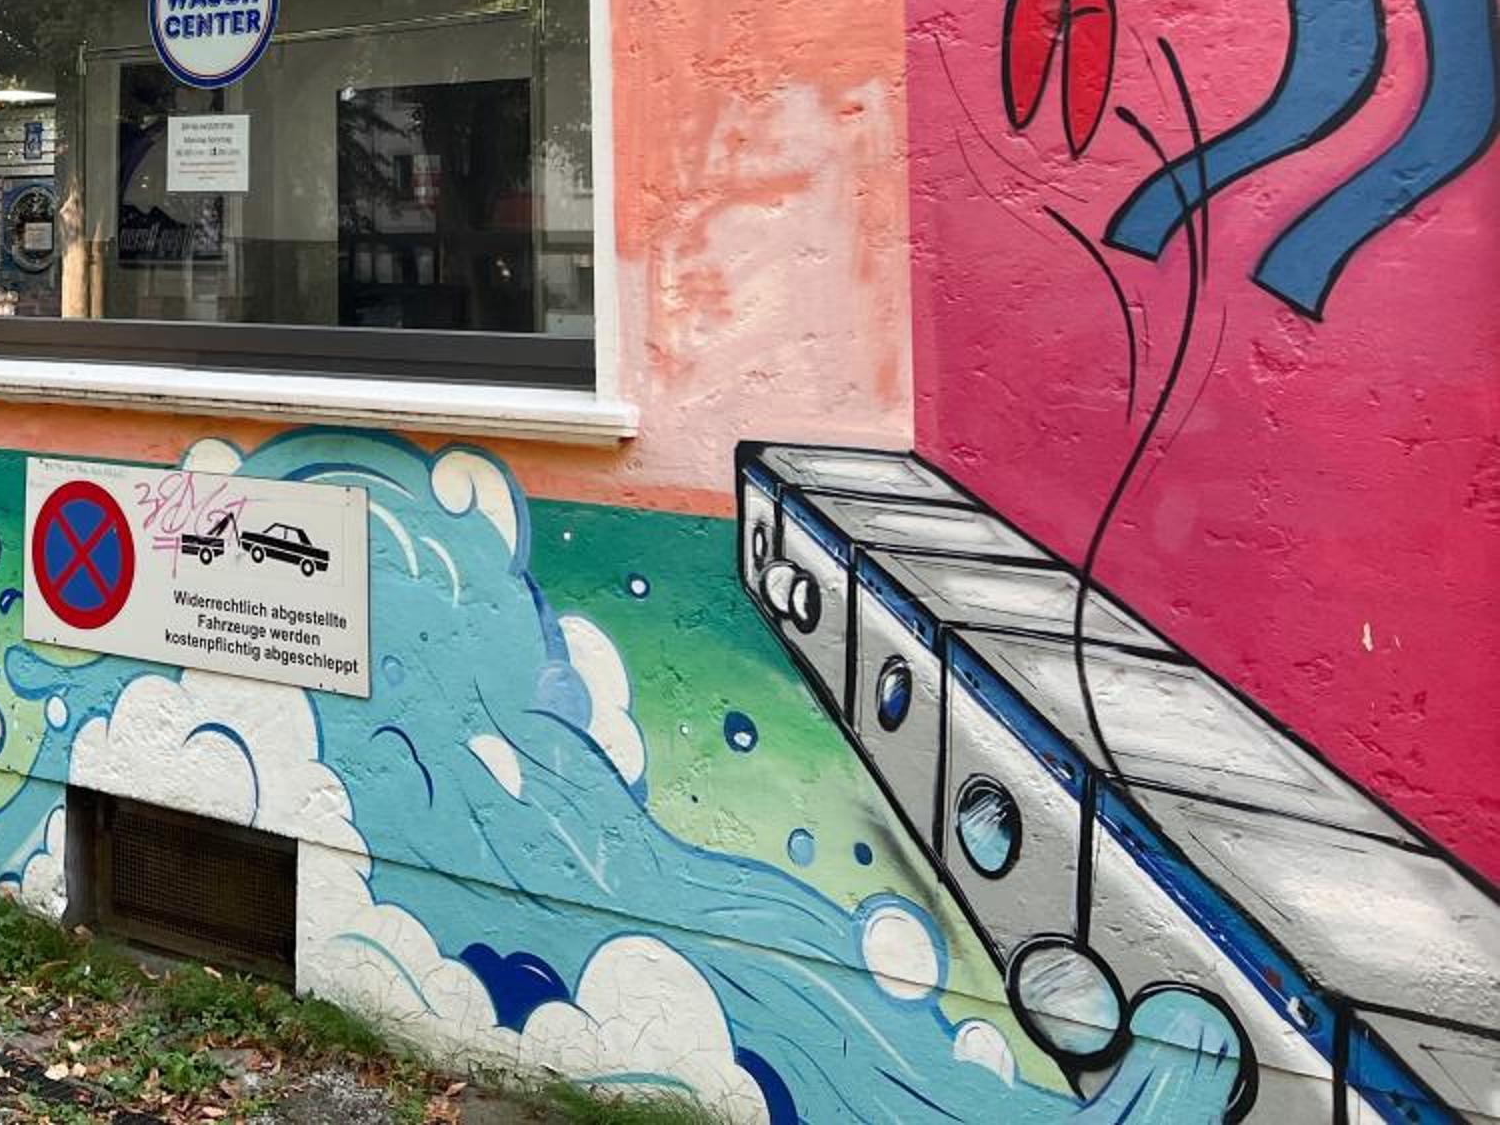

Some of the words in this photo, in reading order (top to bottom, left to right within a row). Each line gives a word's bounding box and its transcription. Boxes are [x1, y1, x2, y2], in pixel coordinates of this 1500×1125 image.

[164, 8, 261, 39] CENTER
[173, 589, 267, 617] Widerrechtlich
[271, 604, 347, 629] abgestellte
[197, 614, 267, 640] Fahrzeuge
[269, 627, 321, 647] werden
[165, 629, 261, 661] kostenpflichtig
[264, 645, 358, 676] abgeschleppt
